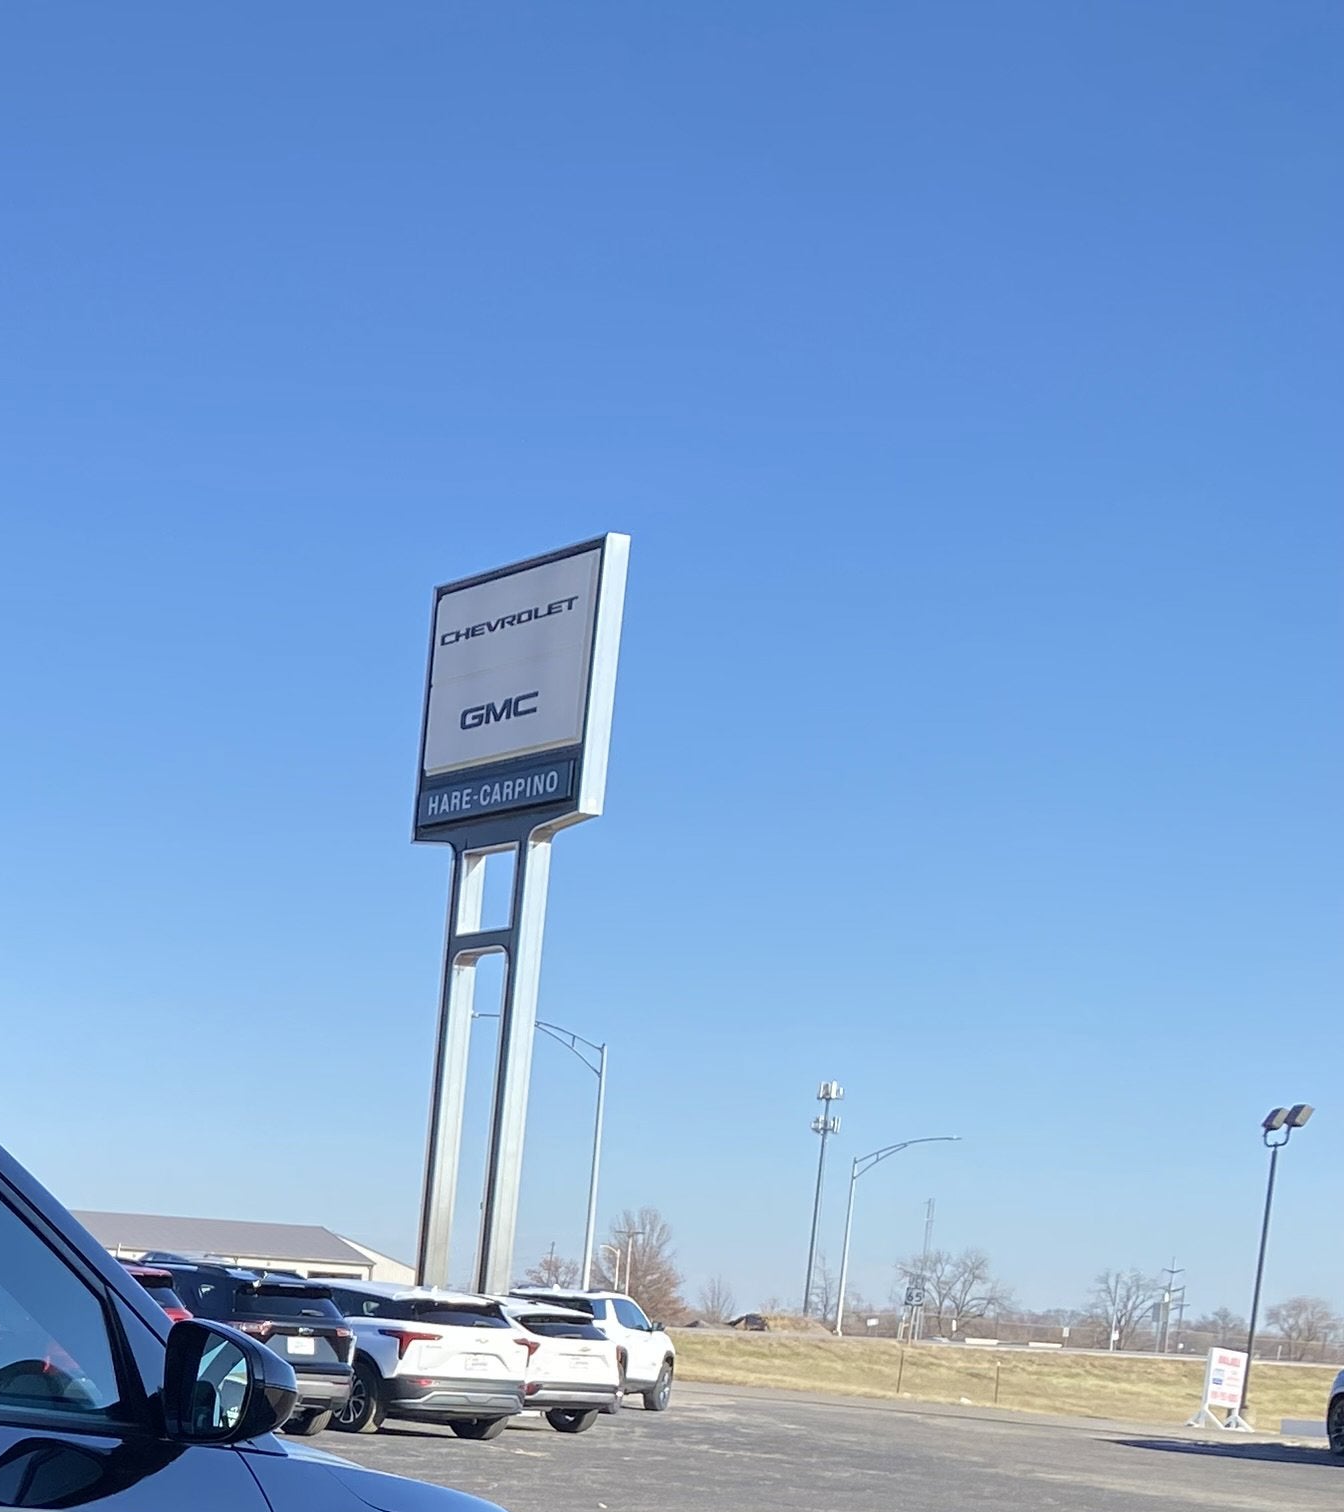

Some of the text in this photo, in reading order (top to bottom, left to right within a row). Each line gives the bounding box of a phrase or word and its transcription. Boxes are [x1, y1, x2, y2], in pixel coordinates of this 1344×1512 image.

[440, 596, 579, 646] CHEVROLET
[460, 691, 539, 730] GMC
[427, 770, 559, 816] HARE-CARPINO
[907, 1291, 922, 1302] 65
